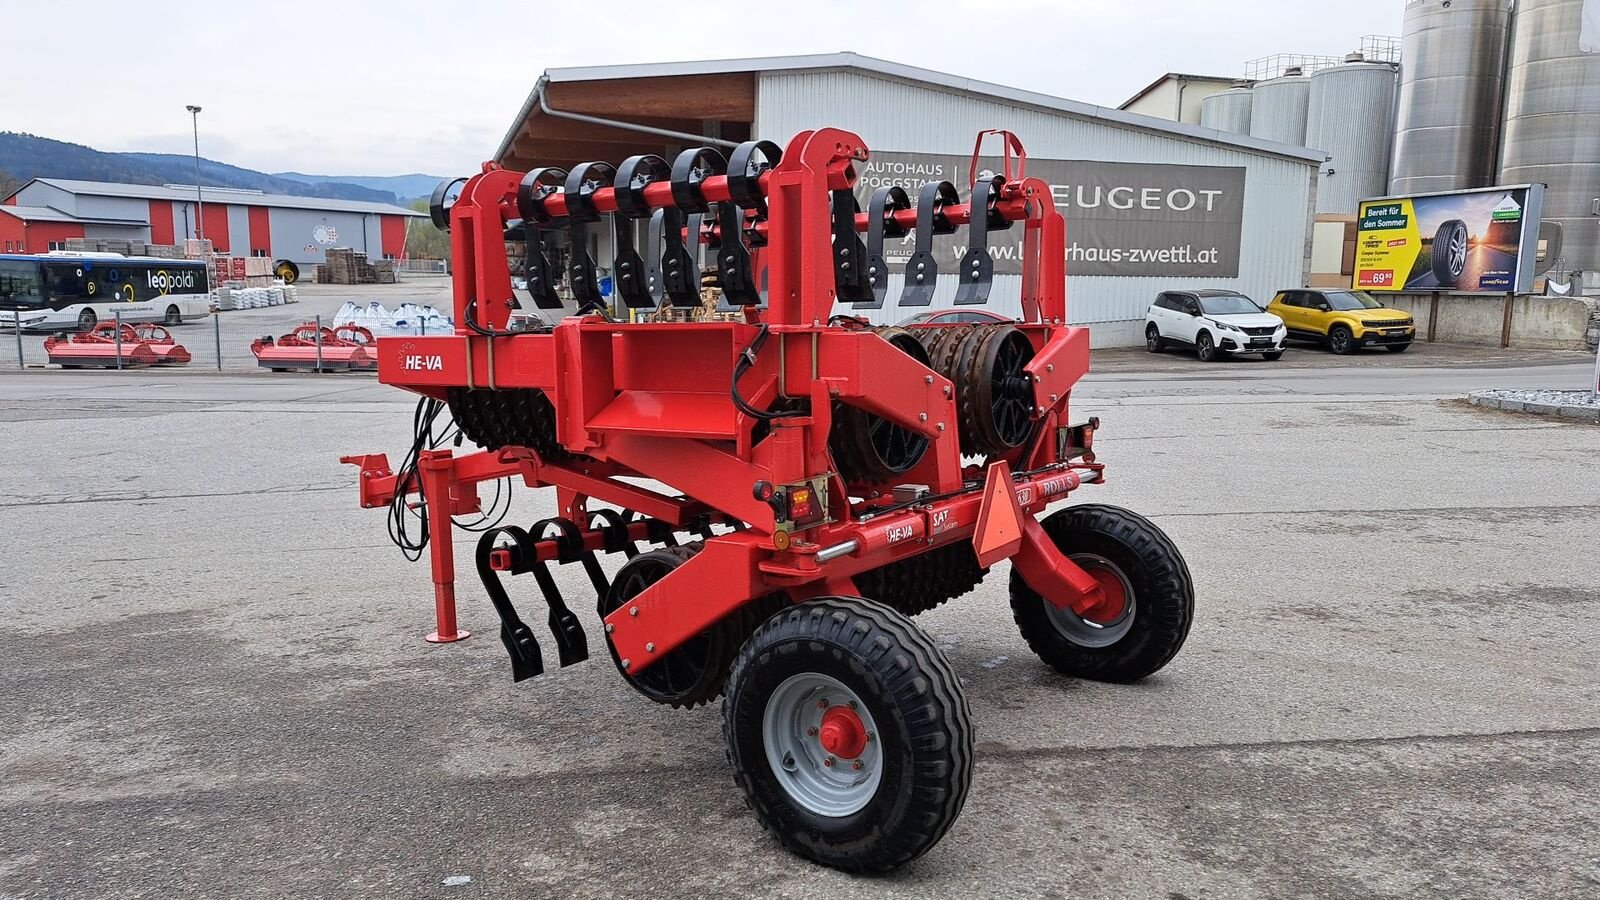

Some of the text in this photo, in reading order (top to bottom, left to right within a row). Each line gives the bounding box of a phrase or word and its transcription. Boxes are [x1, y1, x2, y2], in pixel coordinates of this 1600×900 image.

[865, 161, 943, 175] AUTOHAUS
[860, 174, 942, 189] PÖGGSTA
[1048, 184, 1222, 212] EUGEOT
[1368, 206, 1399, 217] Bereit für
[1364, 219, 1405, 228] den Sommer
[147, 269, 194, 293] leopoldi
[405, 355, 443, 370] HE-VA
[1043, 476, 1073, 496] ROLLS
[933, 509, 949, 527] SAT
[943, 521, 958, 531] System
[889, 525, 913, 543] HE-VA
